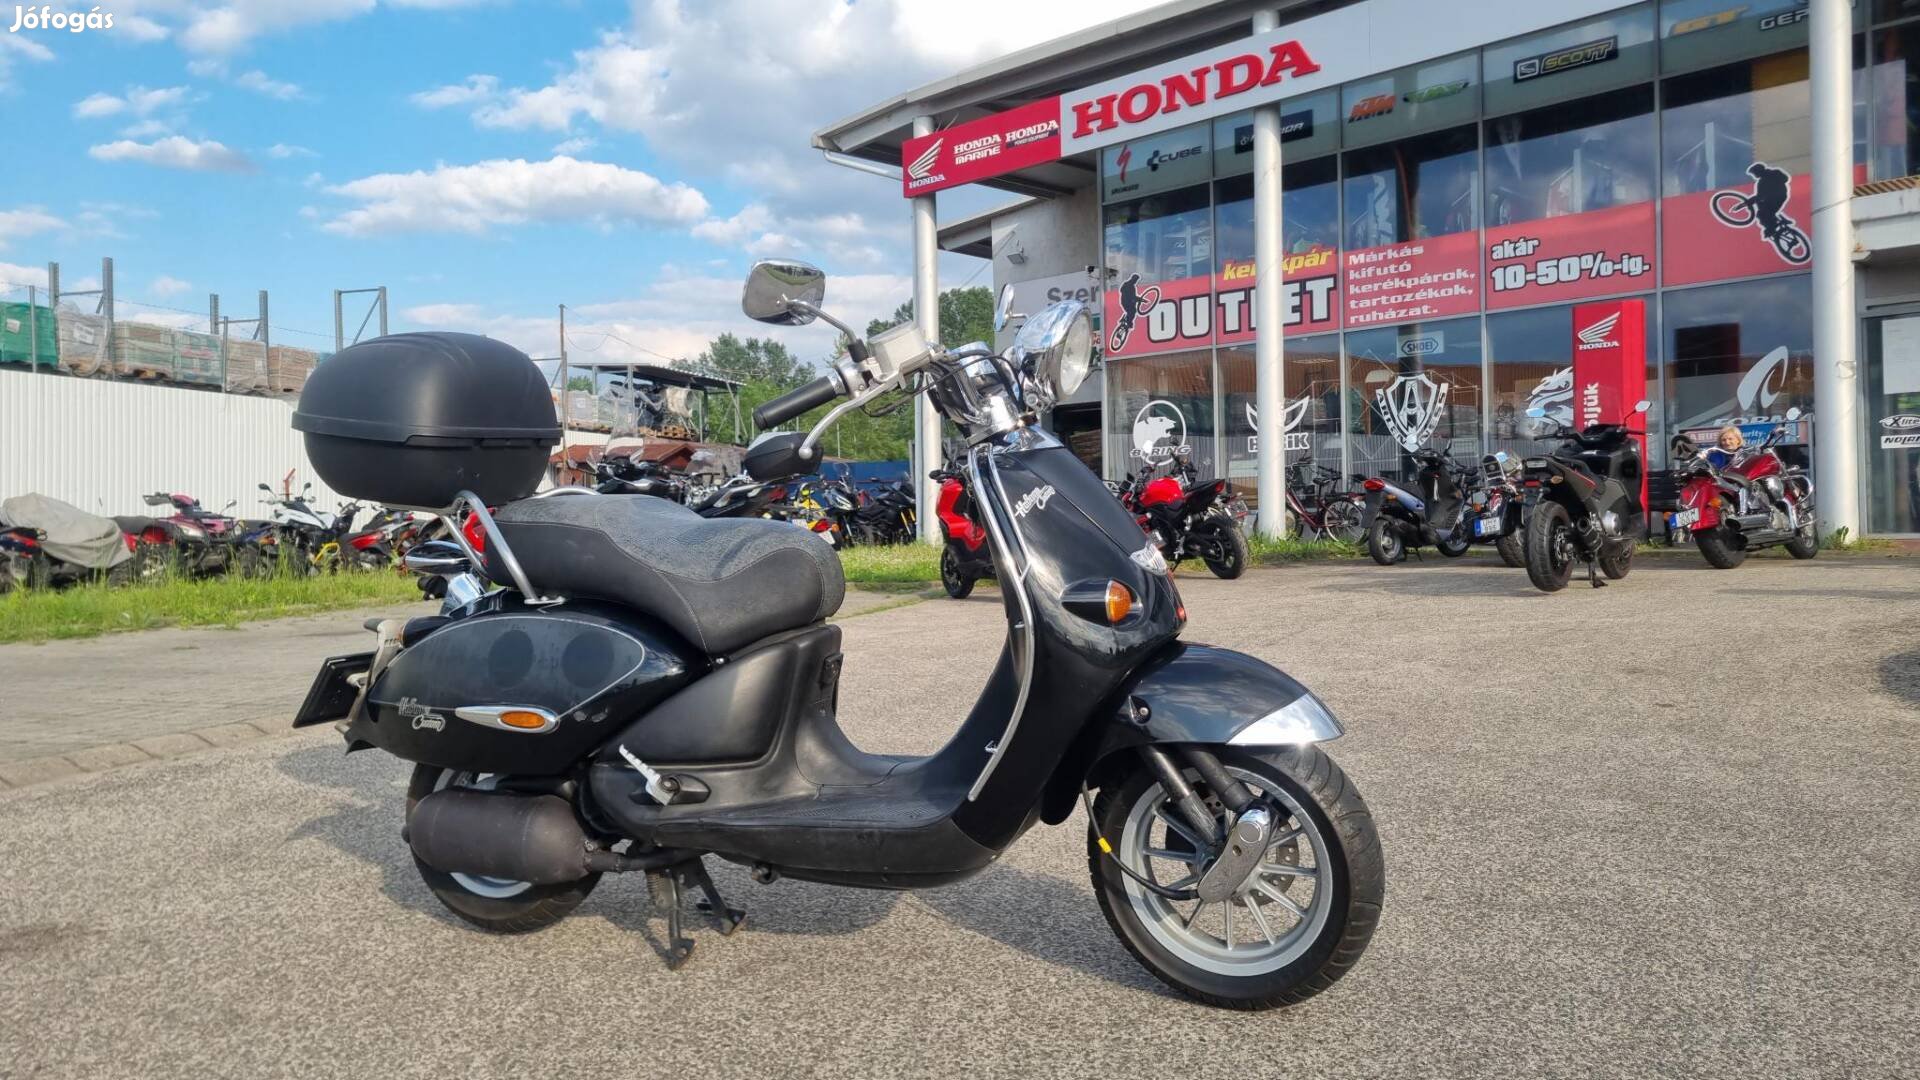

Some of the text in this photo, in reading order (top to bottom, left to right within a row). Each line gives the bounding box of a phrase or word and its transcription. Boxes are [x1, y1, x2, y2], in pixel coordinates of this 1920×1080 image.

[1544, 43, 1610, 69] SCOTT
[1072, 39, 1321, 139] HONDA
[1005, 119, 1059, 143] HONDA
[953, 133, 1001, 155] HONDA
[1158, 146, 1202, 163] CUBE
[955, 146, 1000, 165] MARINE
[908, 173, 946, 189] HONDA
[1349, 245, 1424, 265] Márkás
[1491, 238, 1540, 260] akár
[1223, 249, 1332, 281] kepár
[1349, 261, 1411, 280] kifutó
[1491, 252, 1650, 291] 10-50%-ig.
[1350, 268, 1475, 295] kerékpárok,
[1350, 284, 1473, 309] tartozékok,
[1350, 305, 1438, 324] ruházat.
[1406, 341, 1434, 353] SHOEI
[1579, 341, 1619, 351] HONDA
[1130, 444, 1192, 458] BRING
